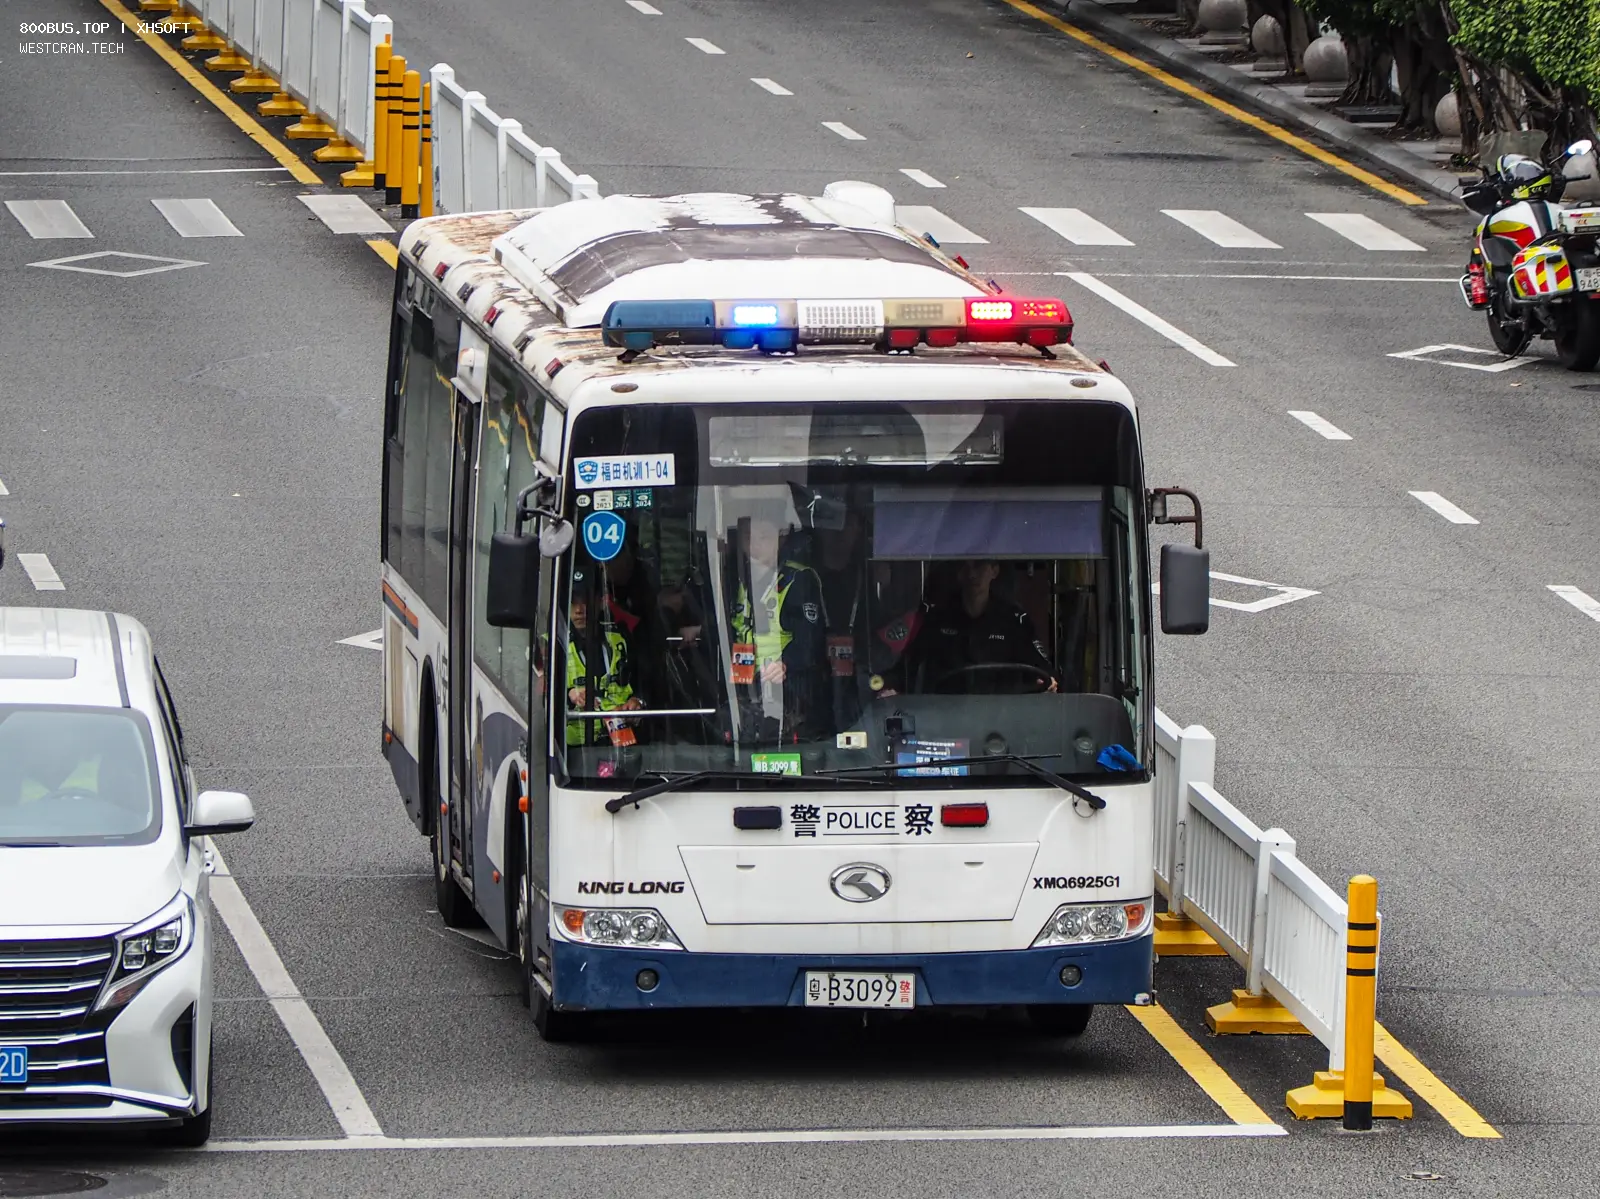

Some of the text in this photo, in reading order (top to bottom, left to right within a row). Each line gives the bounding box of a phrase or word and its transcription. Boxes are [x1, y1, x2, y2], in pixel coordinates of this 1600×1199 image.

[636, 499, 652, 507] 2024
[587, 522, 620, 544] 04
[769, 761, 789, 773] 3099
[790, 804, 934, 837] 警 POLICE 察
[578, 881, 685, 894] KING LONG
[1033, 875, 1120, 889] XMQ6925G1
[0, 1052, 24, 1077] 2D
